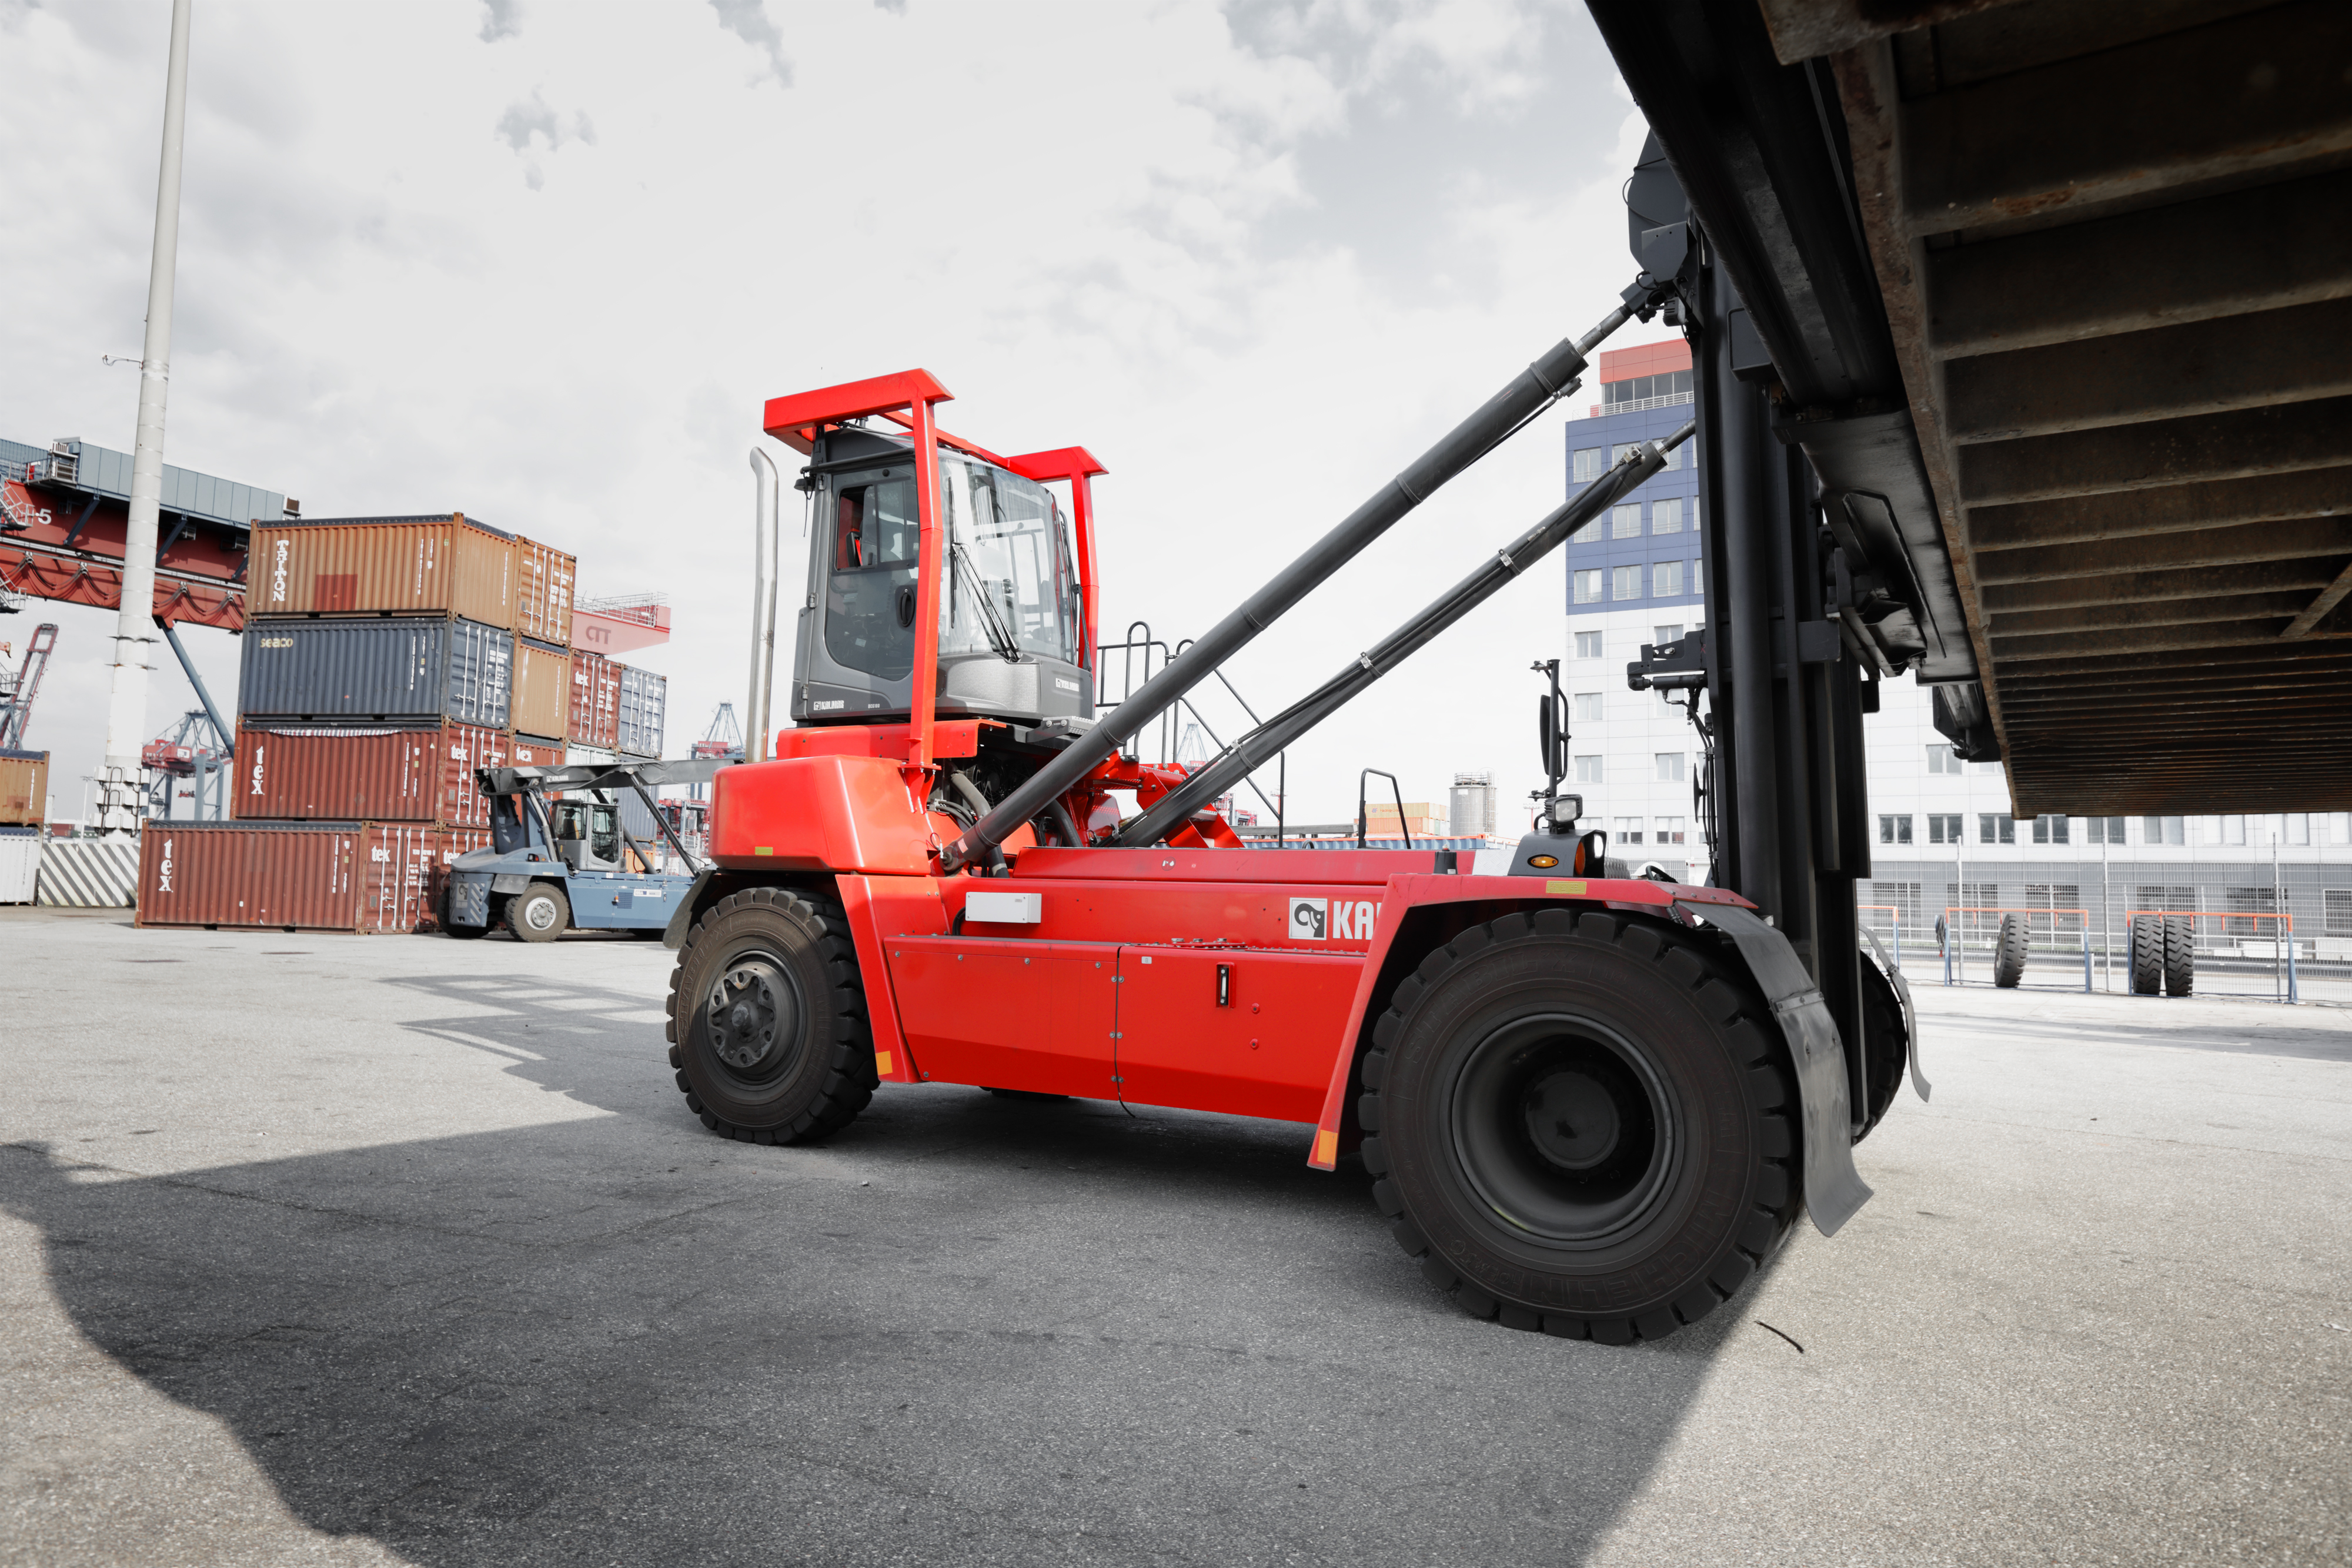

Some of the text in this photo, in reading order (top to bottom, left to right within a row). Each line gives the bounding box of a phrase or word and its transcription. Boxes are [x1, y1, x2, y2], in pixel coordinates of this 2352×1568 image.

[38, 508, 52, 524] 5
[272, 540, 289, 601] TRITON
[260, 637, 293, 648] seaco
[586, 626, 612, 644] CTT
[821, 700, 844, 710] KALMAR
[451, 744, 468, 761] tex
[251, 746, 264, 794] tex
[372, 845, 390, 862] tex
[158, 838, 173, 891] tex
[1332, 901, 1382, 940] KA
[1530, 1186, 1738, 1308] MICHELIN
